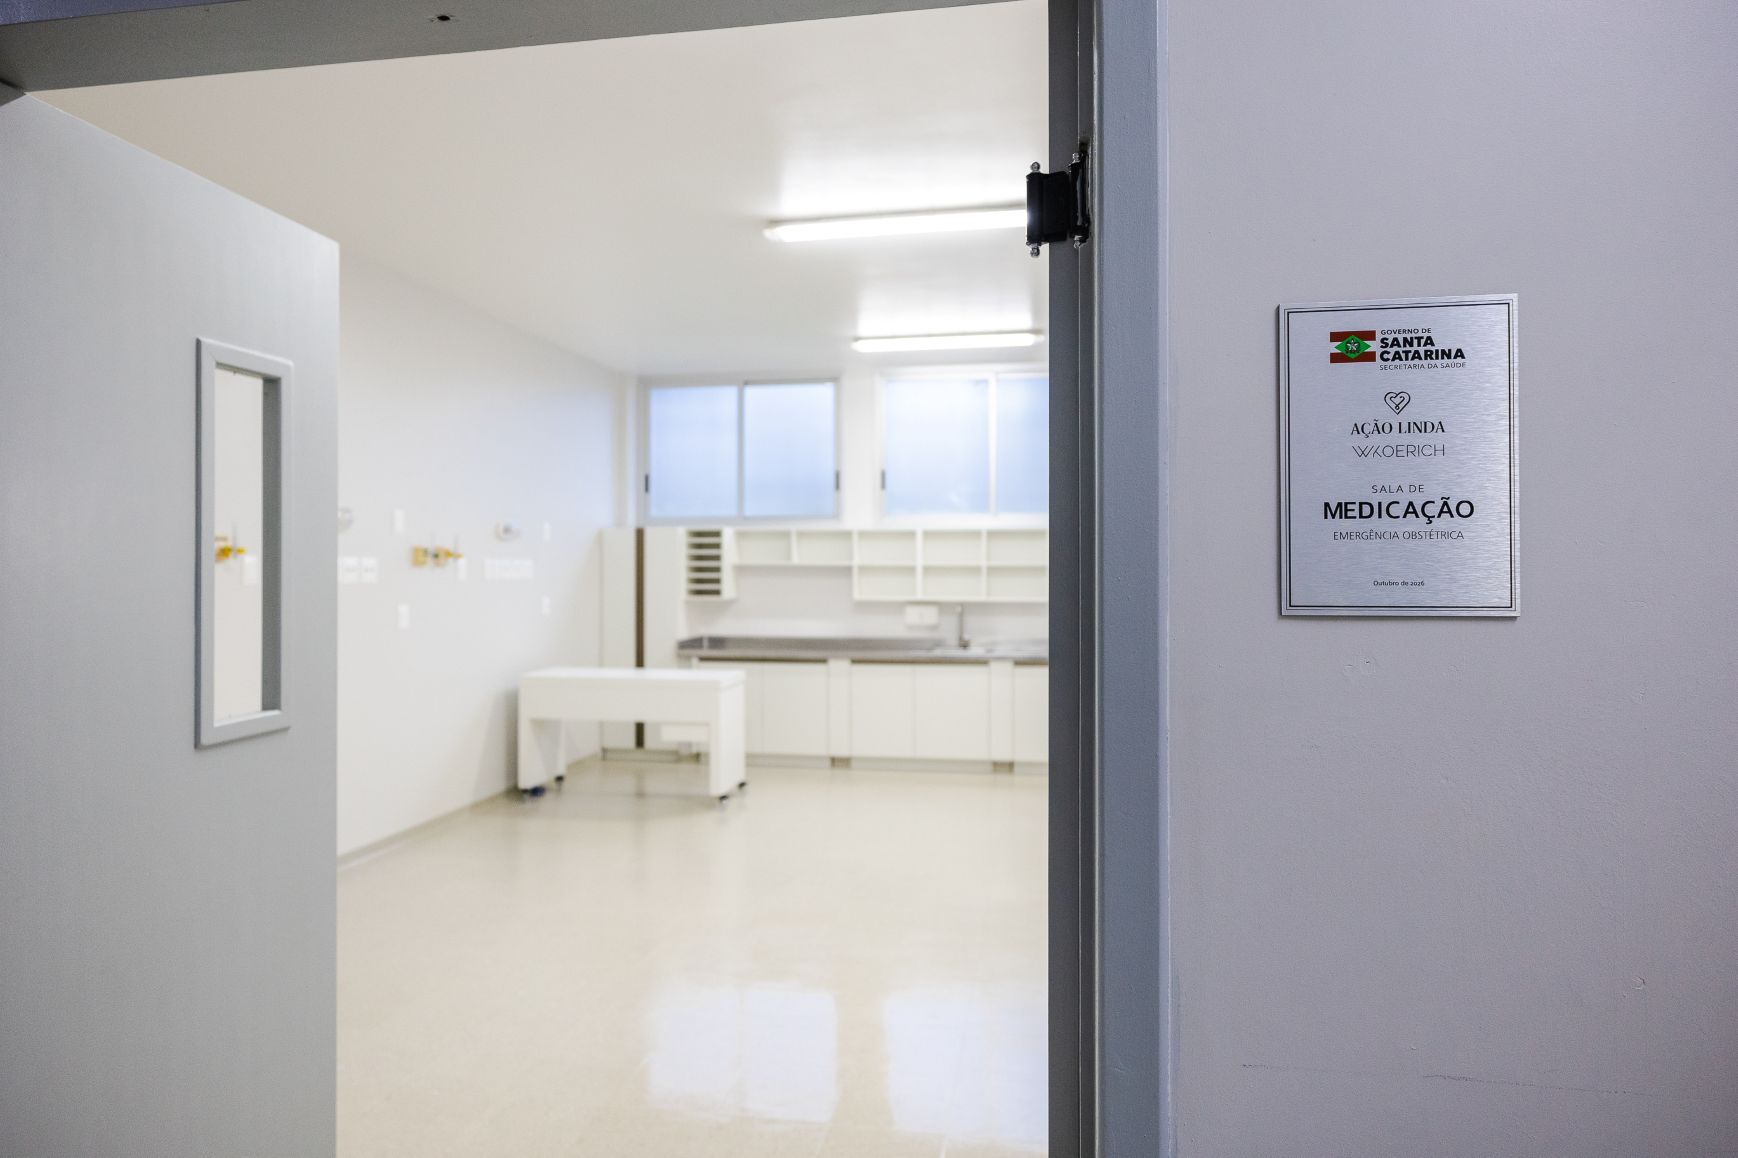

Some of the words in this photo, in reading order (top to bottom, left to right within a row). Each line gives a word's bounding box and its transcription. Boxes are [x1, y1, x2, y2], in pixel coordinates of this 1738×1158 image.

[1380, 328, 1419, 336] GOVERNO
[1379, 335, 1435, 349] SANTA
[1379, 348, 1466, 362] CATARINA
[1379, 363, 1426, 371] SECRETARIA
[1440, 361, 1467, 369] SAÚDE
[1350, 419, 1393, 438] AÇÃO
[1398, 421, 1446, 434] LINDA
[1352, 444, 1445, 458] WKOERICH
[1371, 484, 1404, 494] SALA
[1408, 484, 1425, 493] DE
[1323, 496, 1475, 524] MEDICAÇÃO
[1333, 529, 1400, 541] EMERGÊNCIA
[1402, 529, 1465, 540] OBSTÉTRICA
